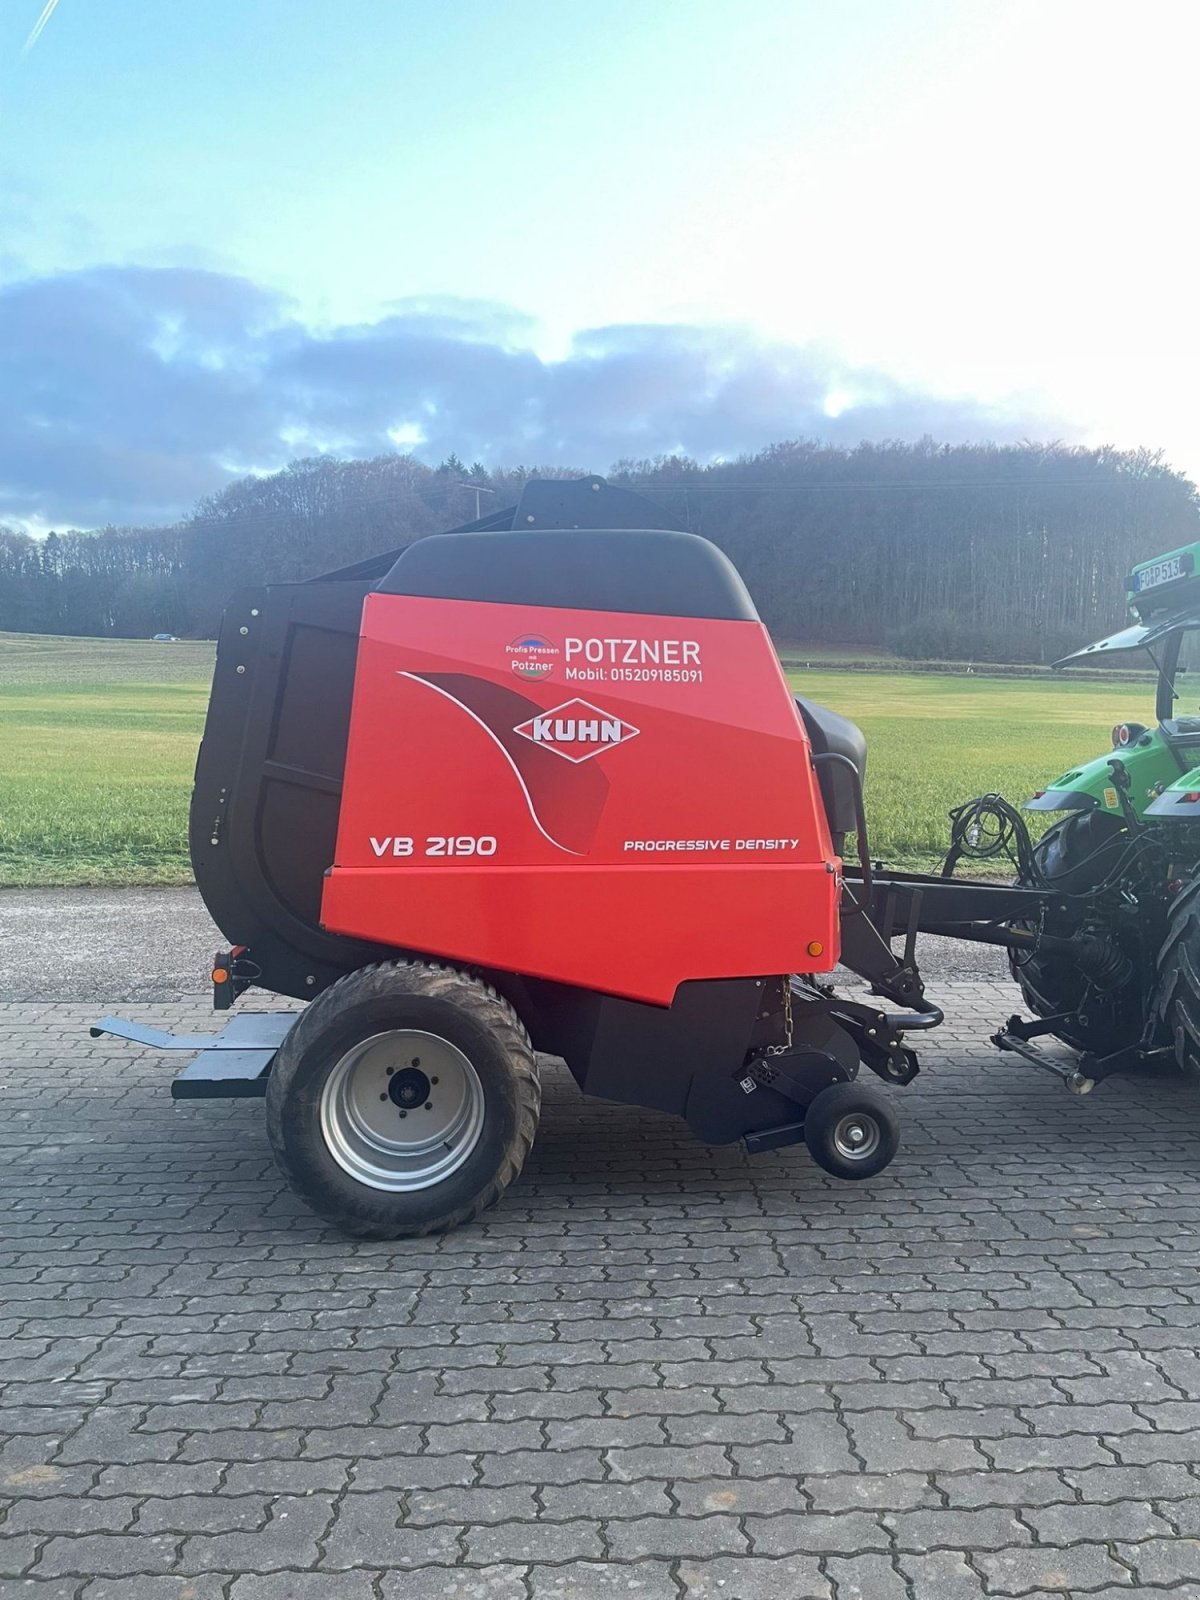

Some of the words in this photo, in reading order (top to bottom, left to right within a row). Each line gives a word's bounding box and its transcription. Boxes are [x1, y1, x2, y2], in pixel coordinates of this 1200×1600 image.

[1162, 560, 1179, 580] 513
[529, 646, 560, 655] Pressen
[565, 638, 701, 665] POTZNER
[511, 660, 554, 671] Potzner
[565, 667, 608, 681] Mobil:
[611, 668, 703, 683] 015209185091
[533, 719, 621, 742] KUHN
[369, 837, 414, 857] VB
[425, 836, 497, 856] 2190
[624, 840, 730, 851] PROGRESSIVE
[735, 839, 799, 850] DENSITY
